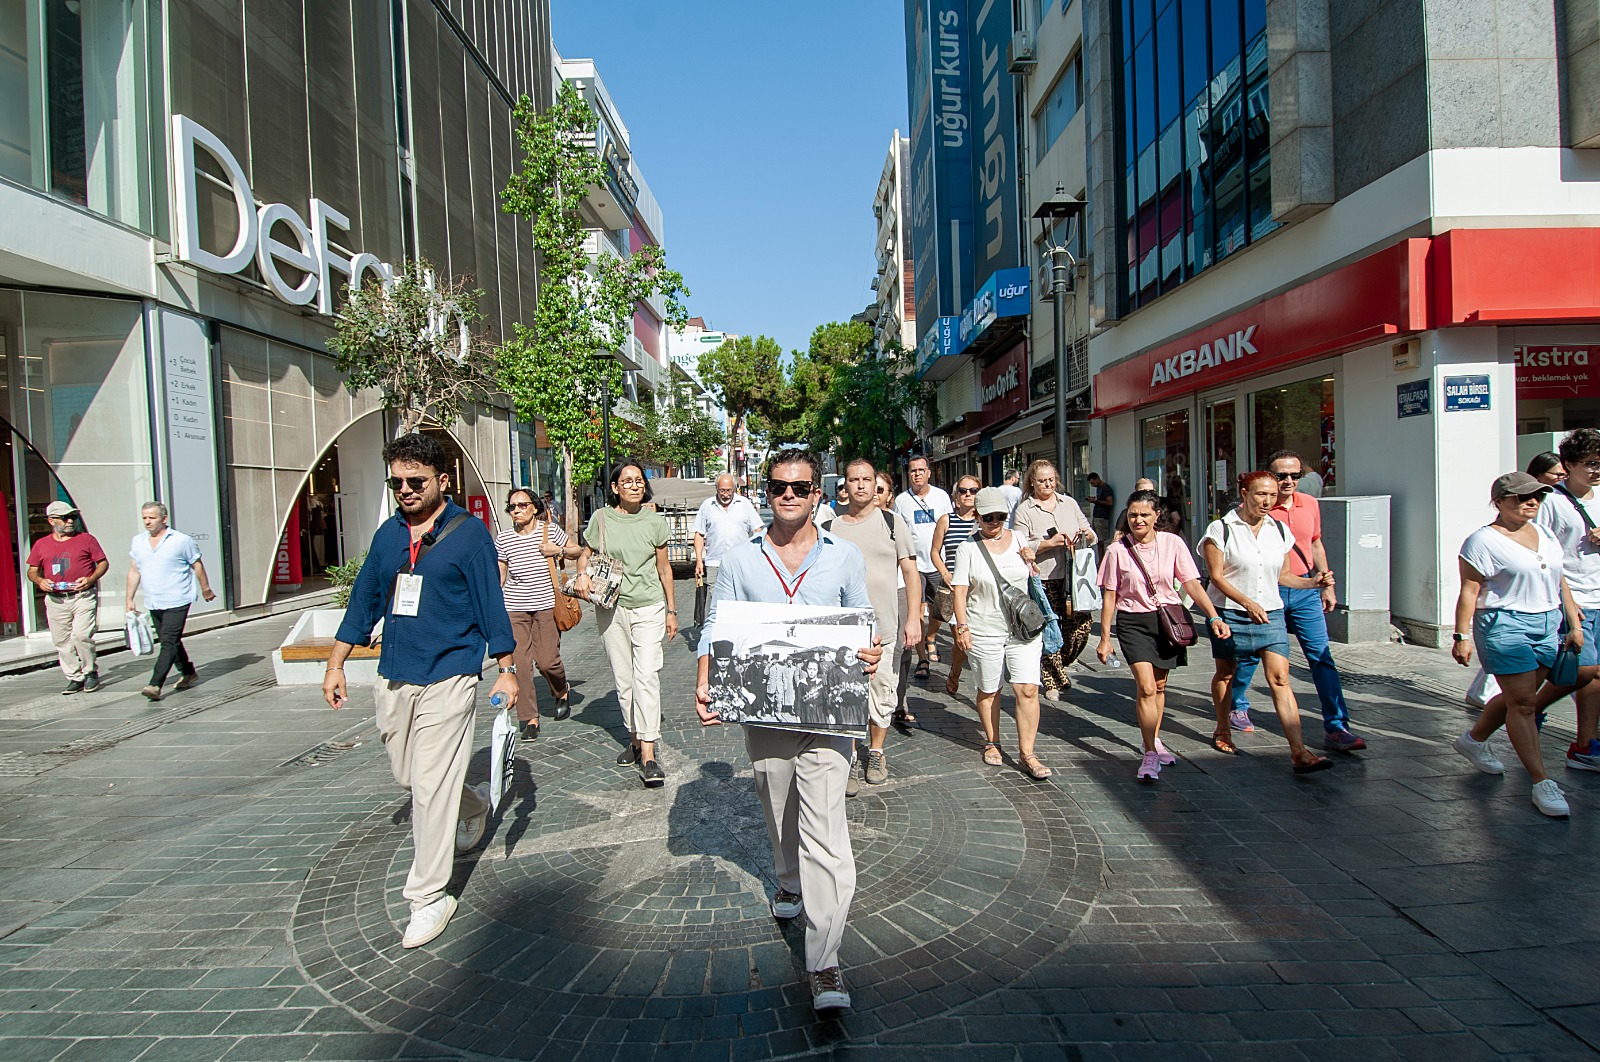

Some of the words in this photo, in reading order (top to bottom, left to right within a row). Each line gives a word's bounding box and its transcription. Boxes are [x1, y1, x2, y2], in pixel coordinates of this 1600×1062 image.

[934, 10, 961, 75] kurs
[935, 78, 968, 147] uğur
[980, 38, 1006, 261] uğur
[999, 283, 1028, 299] uğur
[942, 317, 951, 354] uğur
[180, 356, 196, 364] Çocuk
[1151, 325, 1258, 387] AKBANK
[1514, 346, 1589, 367] Ekstra
[180, 366, 196, 374] Bebek
[1532, 373, 1572, 382] beklemek
[1573, 372, 1589, 382] yok
[171, 380, 178, 388] +2
[181, 382, 196, 390] Erkek
[1446, 385, 1468, 397] SALAH
[1469, 382, 1489, 396] BİRSEL
[1457, 395, 1481, 404] SOKAĞI
